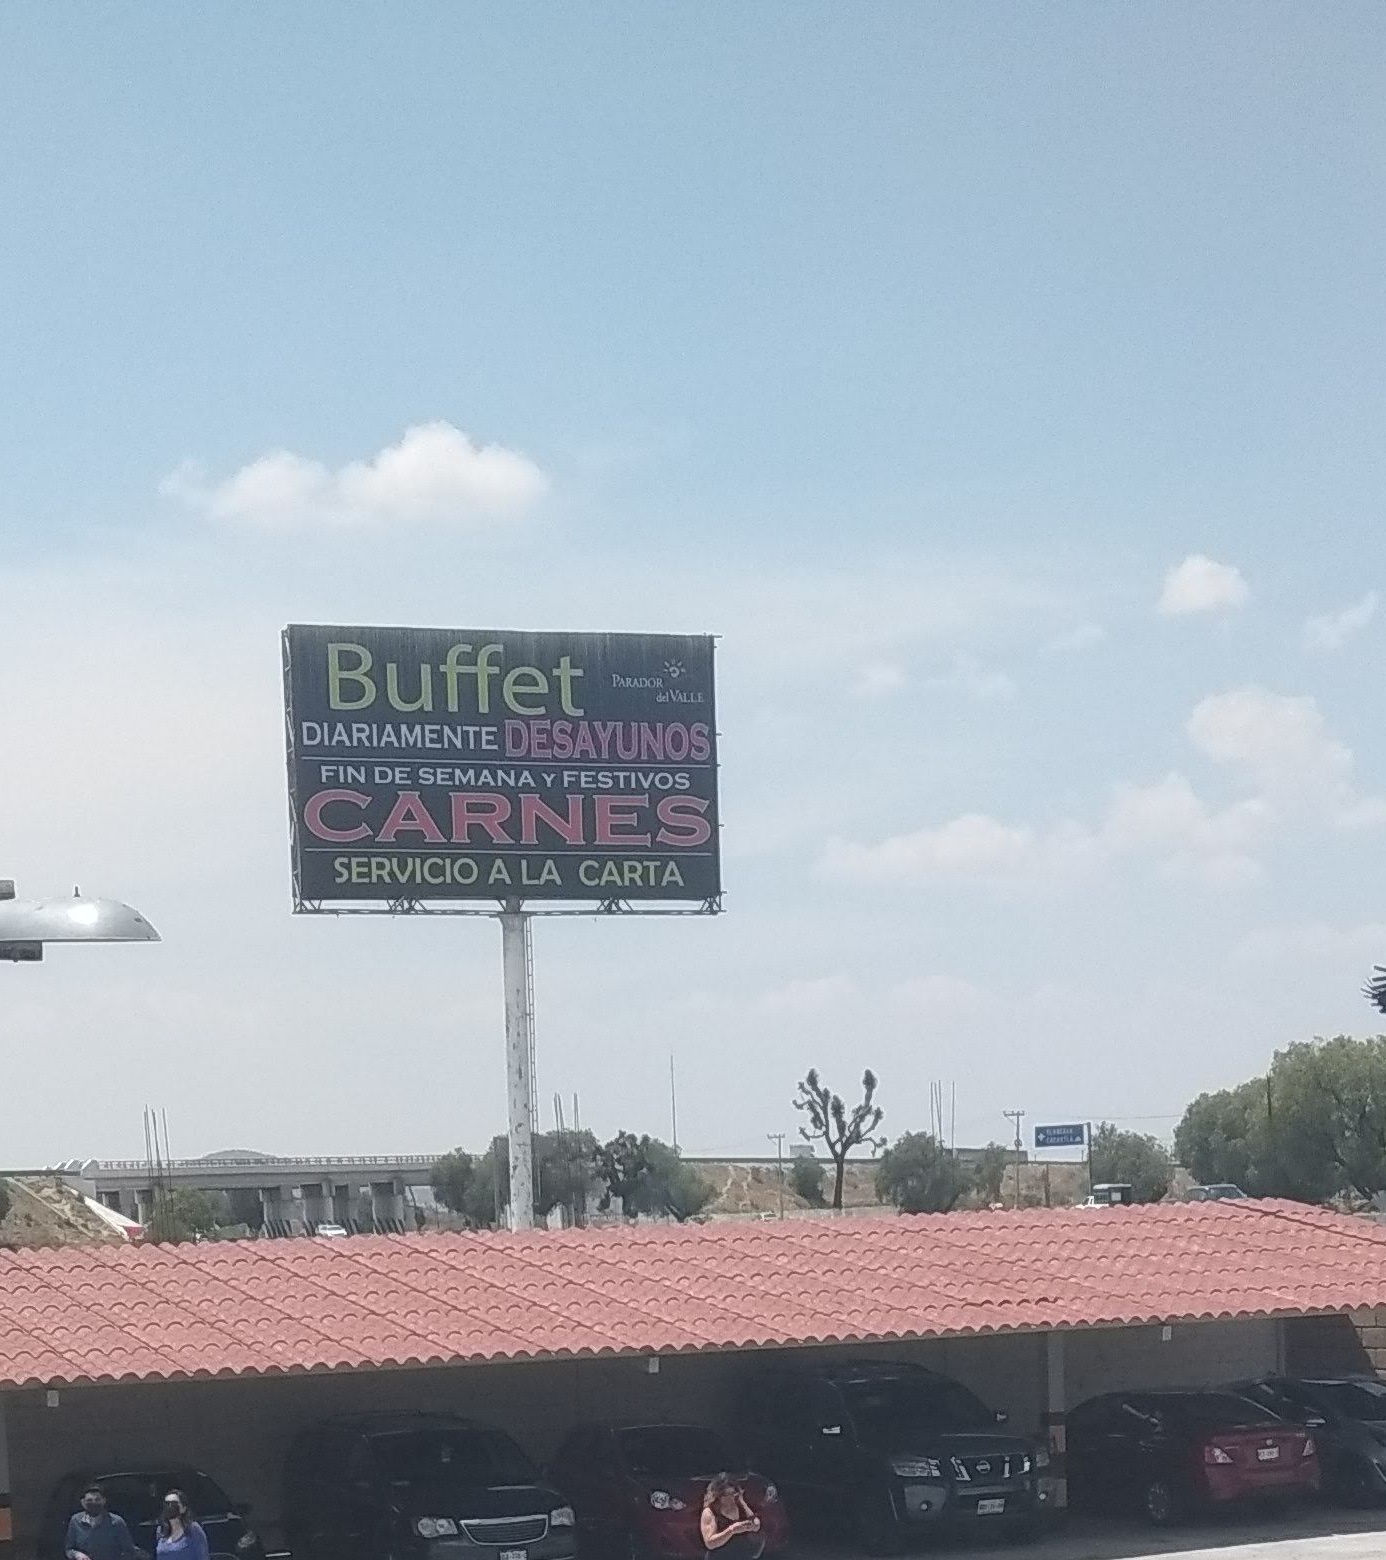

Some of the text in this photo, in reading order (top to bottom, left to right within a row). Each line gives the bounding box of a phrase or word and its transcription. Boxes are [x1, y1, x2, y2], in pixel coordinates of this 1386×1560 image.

[327, 643, 585, 717] Buffet
[301, 719, 711, 761] DIARIAMENTE DESAYUNOS
[320, 765, 366, 784] FIN
[374, 766, 412, 785] DE
[418, 767, 536, 787] SEMANA
[563, 771, 691, 790] FESTIVOS
[303, 789, 712, 848] CARNES
[334, 857, 685, 887] SERVICIO A LA CARTA
